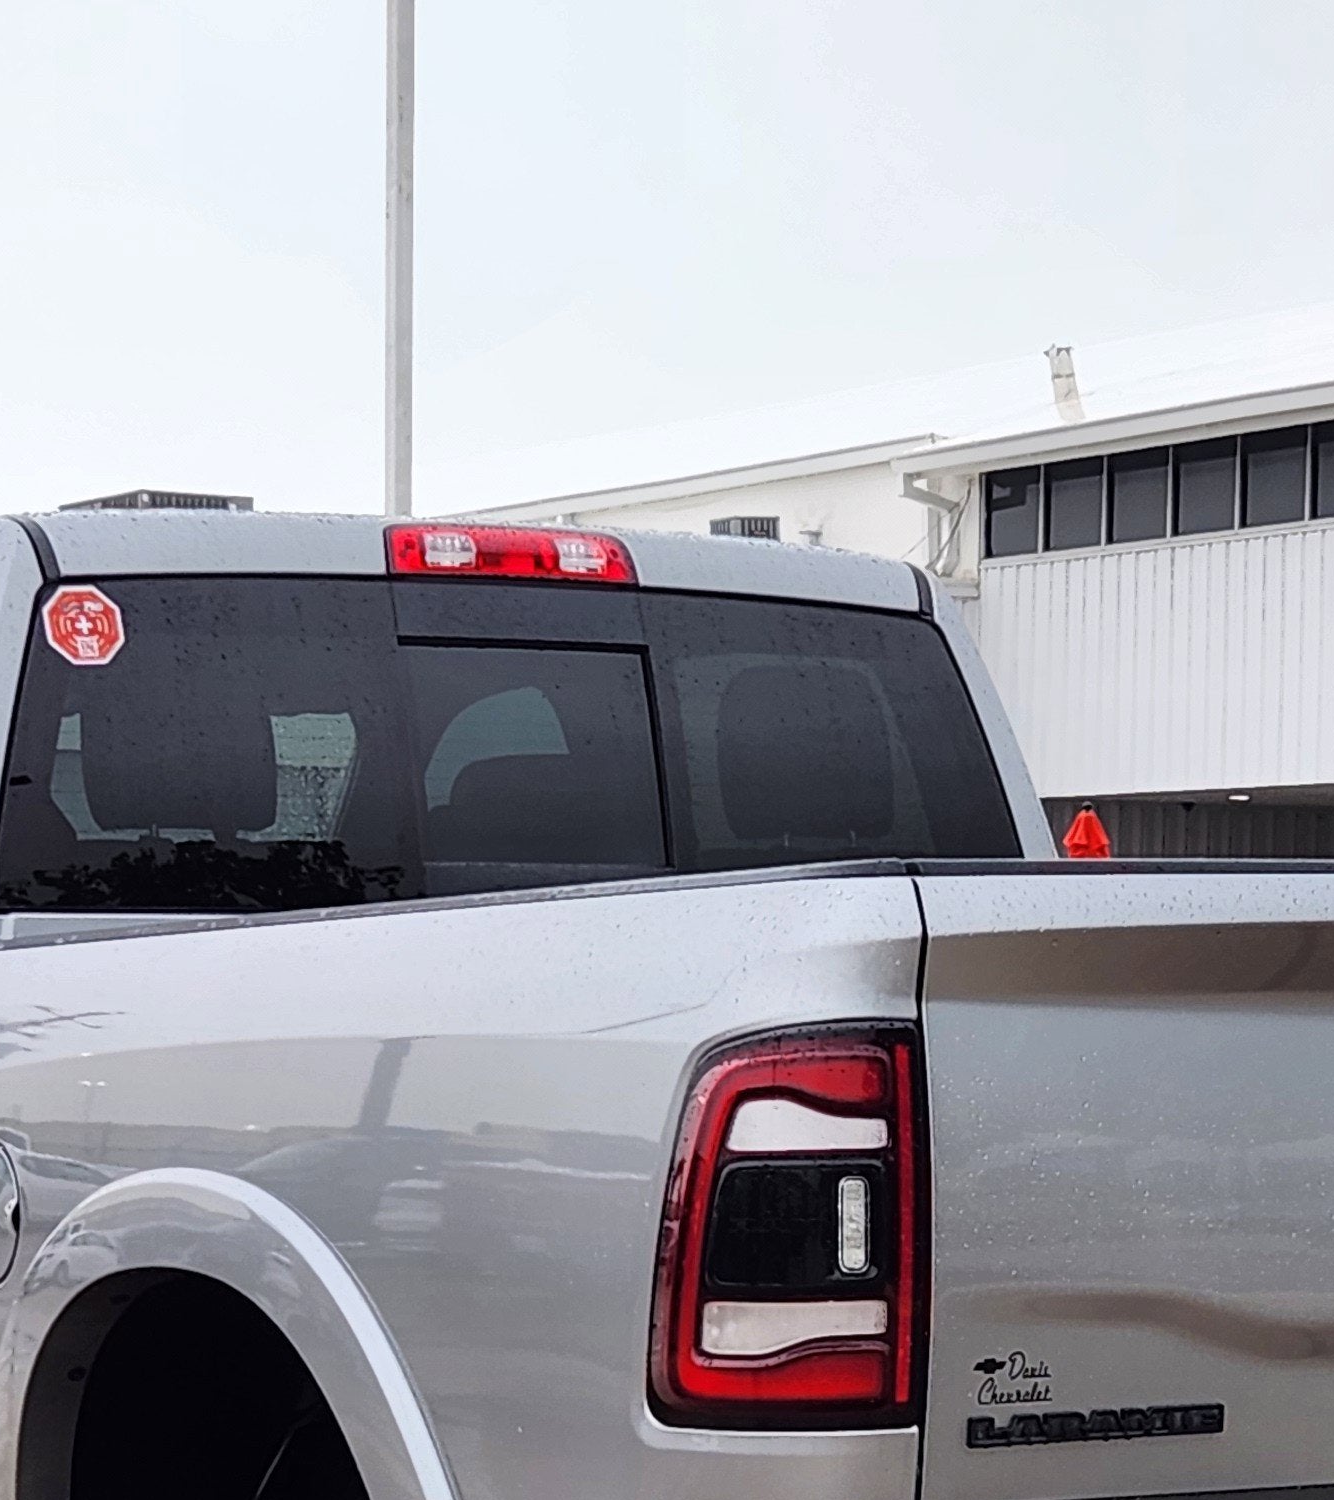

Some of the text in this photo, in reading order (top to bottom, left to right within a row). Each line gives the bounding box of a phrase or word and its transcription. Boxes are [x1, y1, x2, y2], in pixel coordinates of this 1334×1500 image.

[1008, 1351, 1052, 1380] Davis
[978, 1378, 1053, 1405] Chevrolet
[966, 1403, 1225, 1449] LARAMIE
